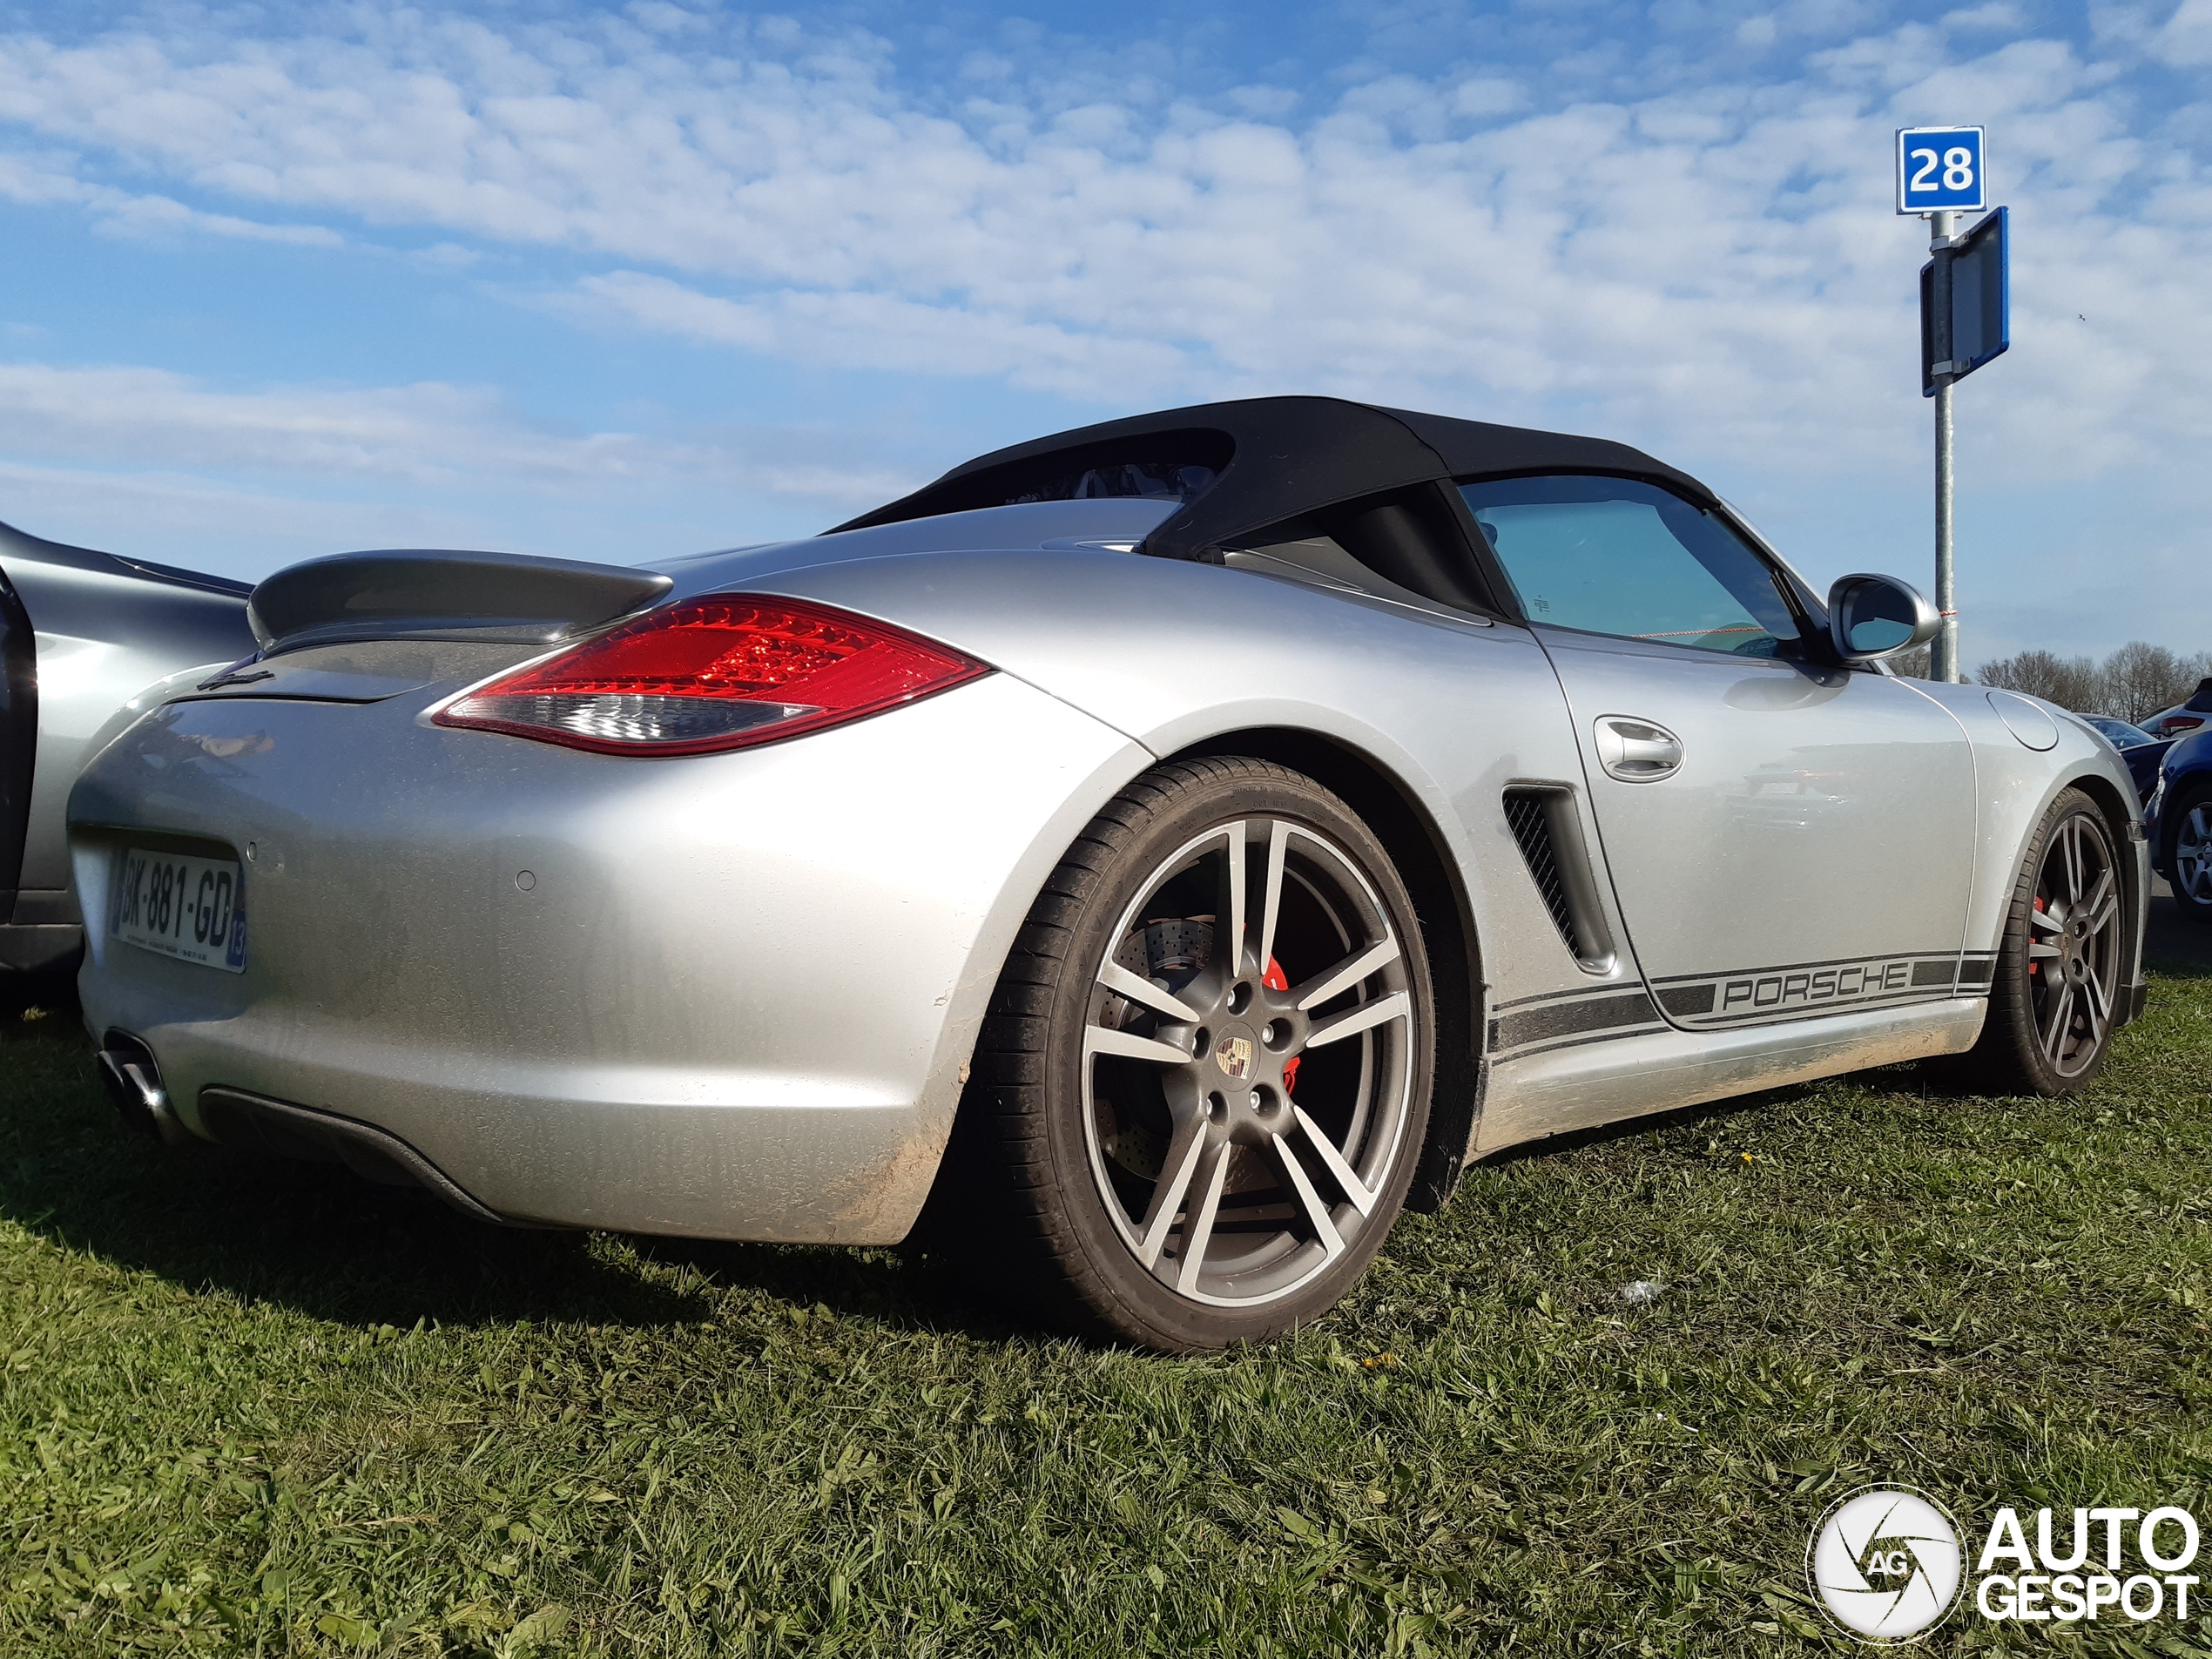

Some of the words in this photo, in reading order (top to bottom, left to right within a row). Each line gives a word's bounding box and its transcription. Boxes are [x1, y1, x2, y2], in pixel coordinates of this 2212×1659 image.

[1910, 146, 1973, 192] 28
[230, 921, 246, 954] 13
[1722, 962, 1910, 1011] PORSCHE
